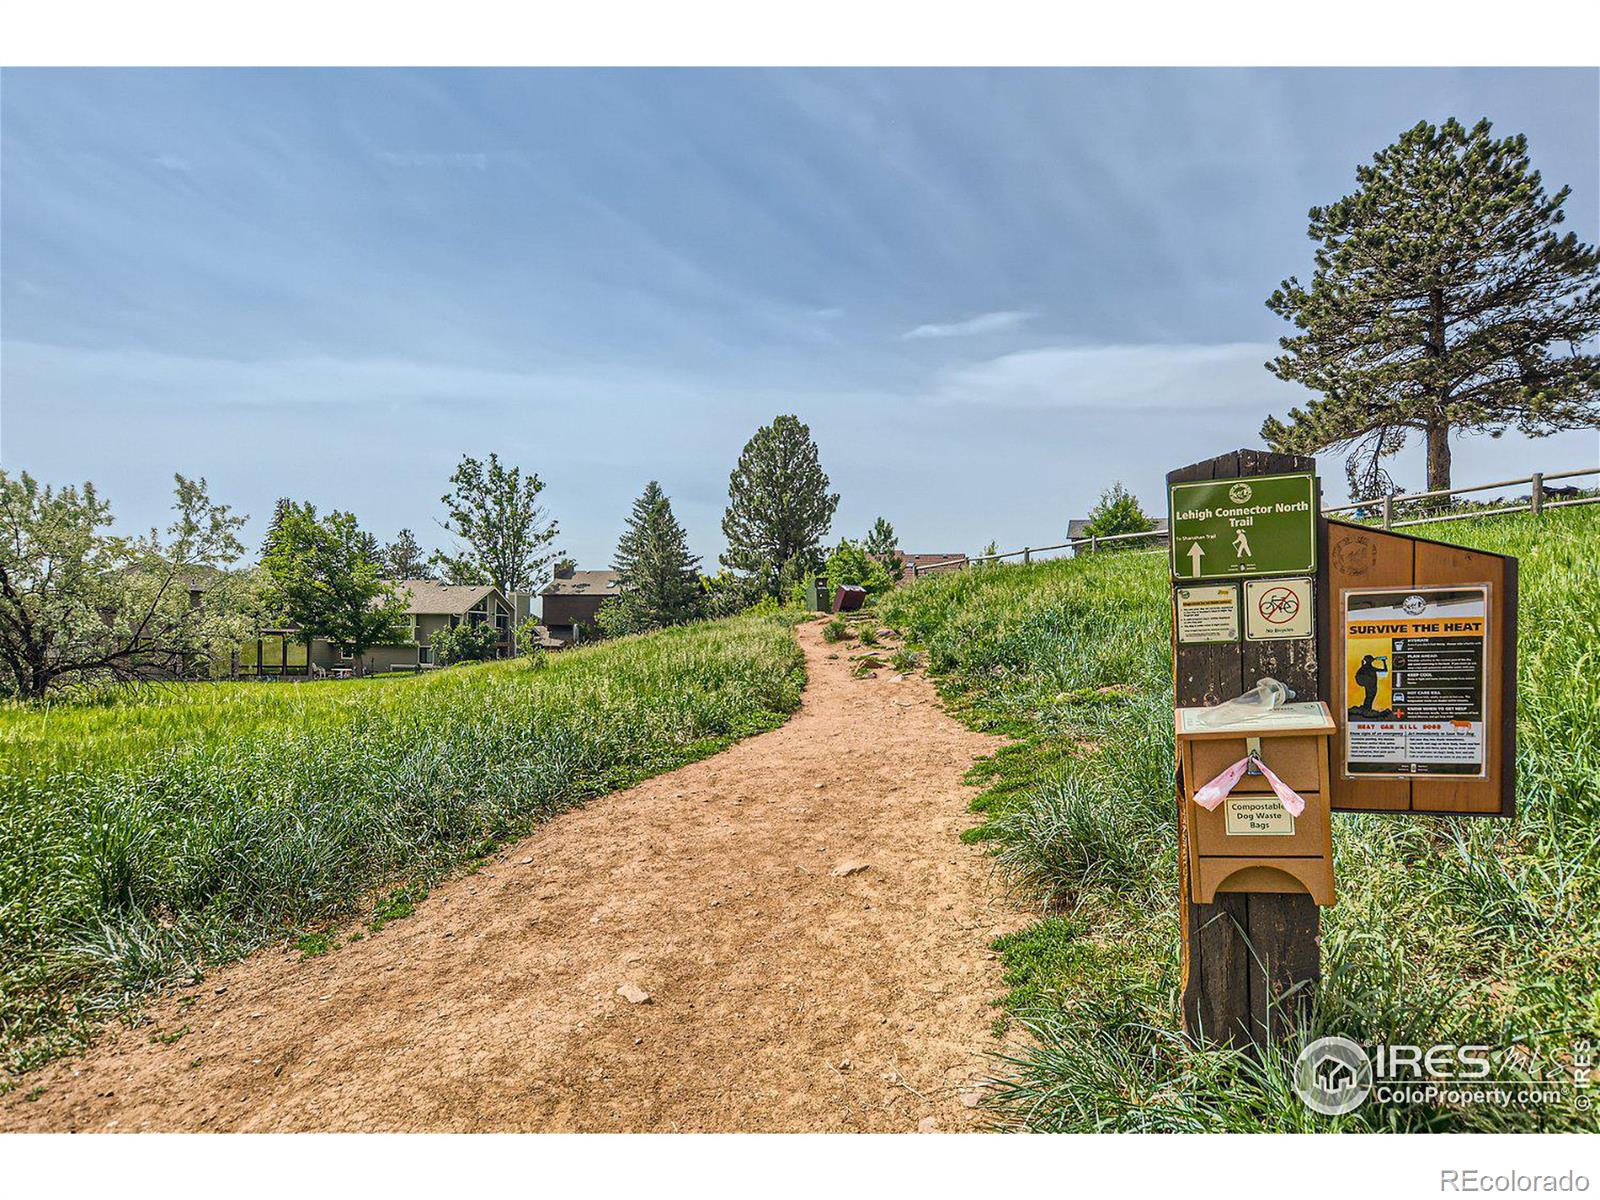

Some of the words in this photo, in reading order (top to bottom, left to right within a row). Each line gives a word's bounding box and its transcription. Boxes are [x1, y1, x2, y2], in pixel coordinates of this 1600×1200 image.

[1176, 509, 1213, 521] Lehigh
[1215, 505, 1273, 518] Connector
[1275, 501, 1309, 513] North
[1229, 517, 1253, 528] Trail
[1349, 624, 1408, 635] SURVIVE
[1412, 623, 1440, 633] THE
[1444, 622, 1482, 632] HEAT
[1236, 812, 1254, 821] Dog
[1250, 822, 1270, 830] Bags
